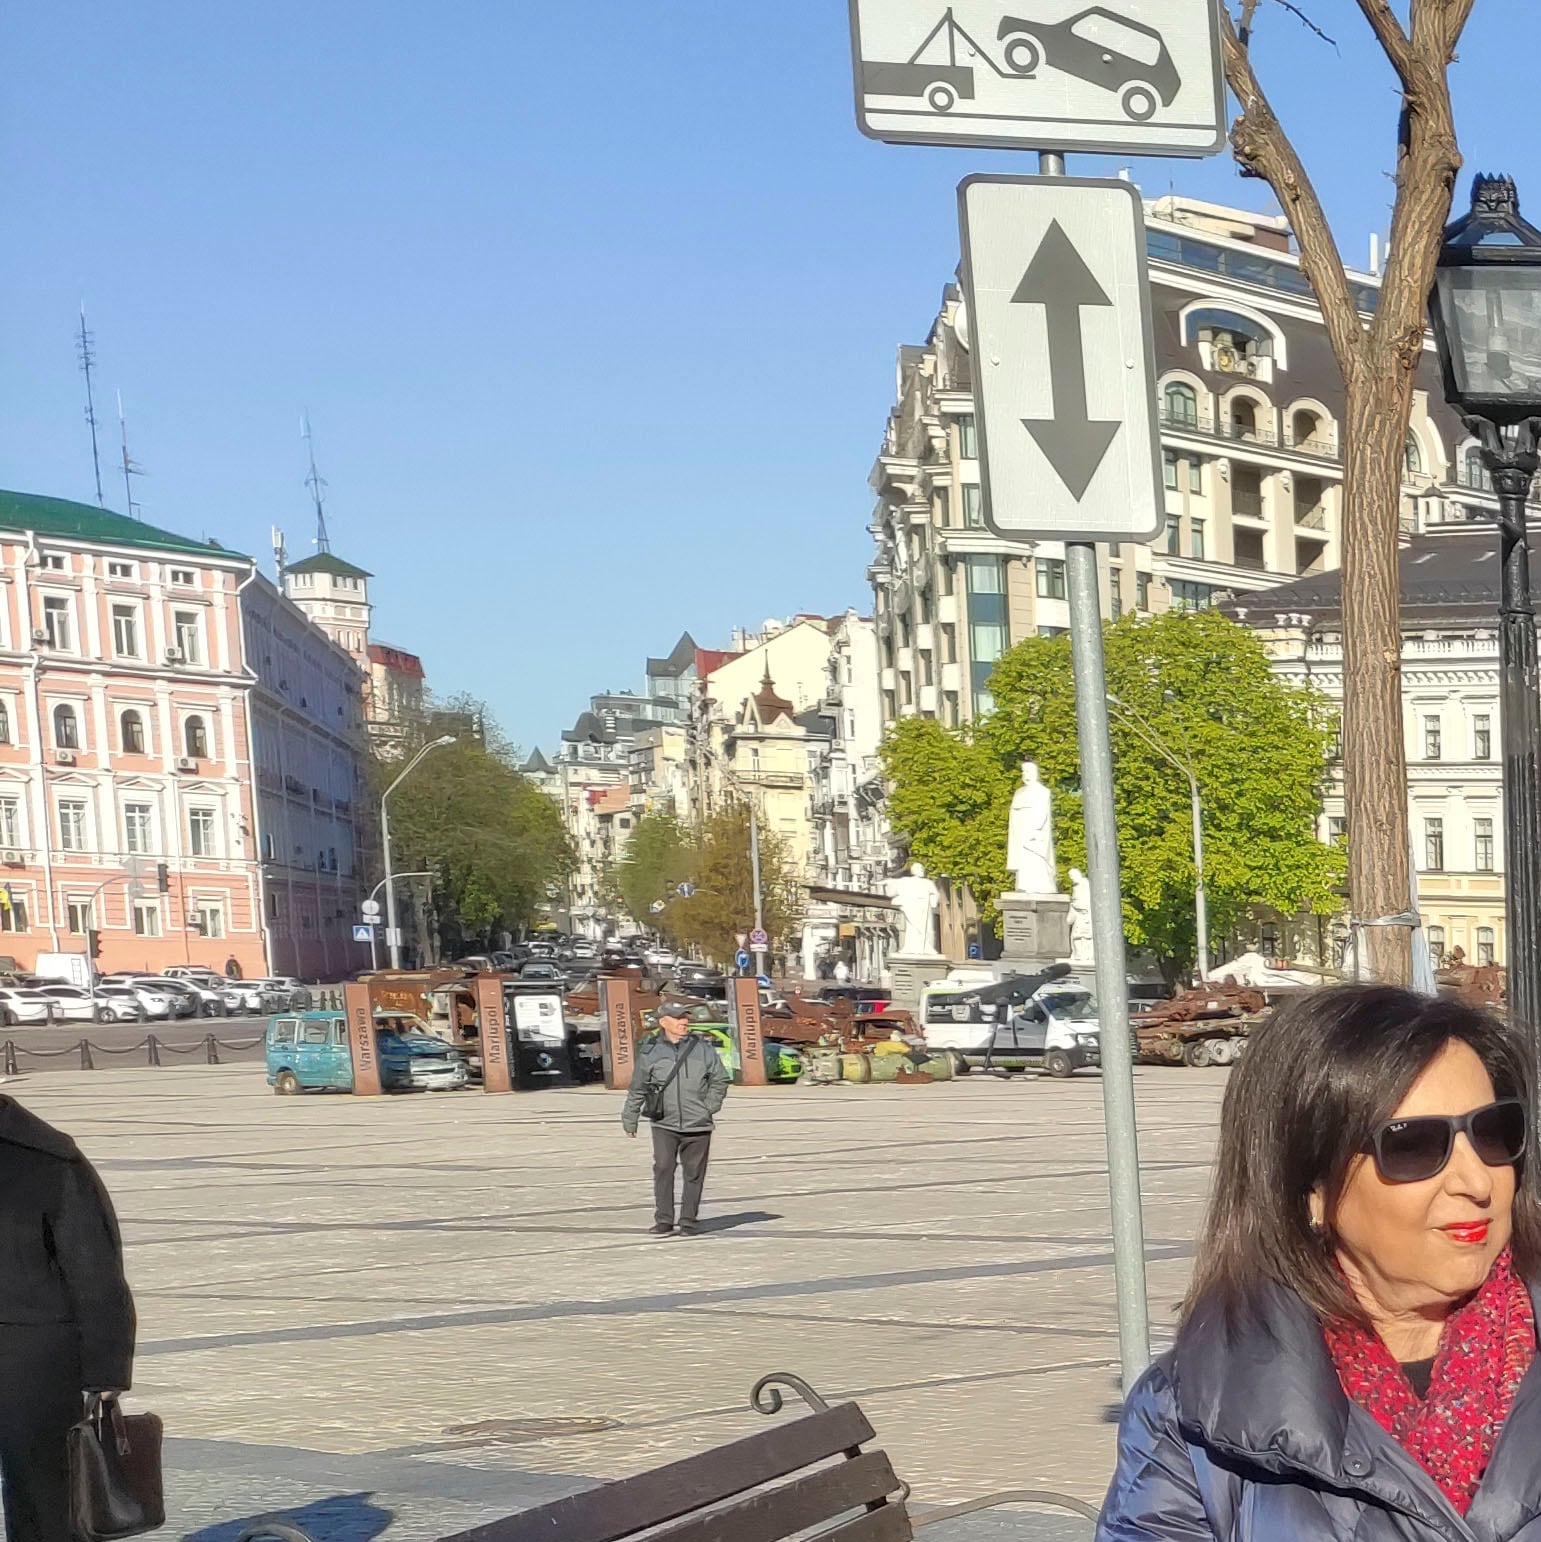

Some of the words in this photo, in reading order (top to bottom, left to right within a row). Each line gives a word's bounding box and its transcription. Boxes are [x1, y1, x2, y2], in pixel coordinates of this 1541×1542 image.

[356, 1007, 373, 1072] Warszawa
[484, 1005, 501, 1064] Mariupol
[615, 1003, 630, 1065] Warszawa
[742, 1003, 759, 1061] Mariupol
